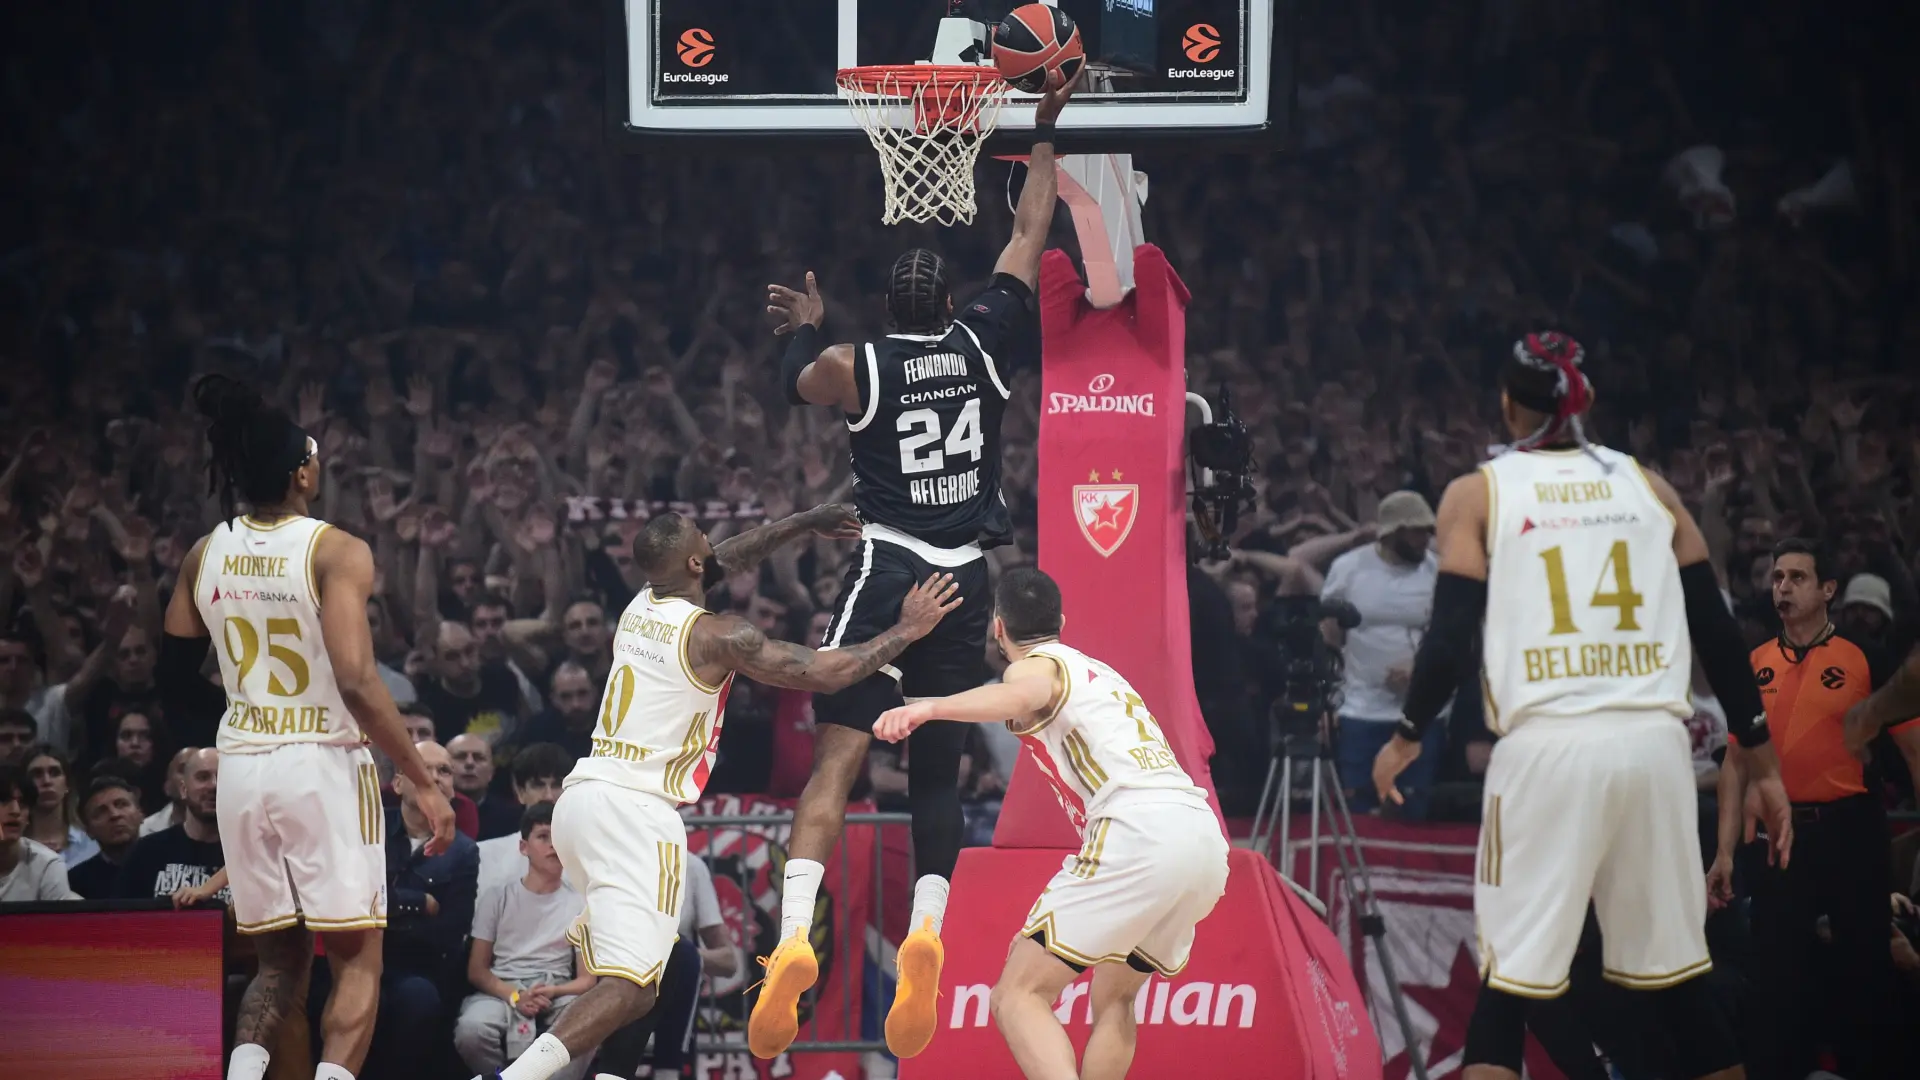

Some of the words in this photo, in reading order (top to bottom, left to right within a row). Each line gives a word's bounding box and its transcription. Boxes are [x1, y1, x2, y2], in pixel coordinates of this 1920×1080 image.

[664, 72, 729, 85] EuroLeague
[1168, 68, 1235, 80] EuroLeague
[904, 353, 967, 385] FERNANDO
[900, 384, 977, 404] CHANGAN
[1048, 392, 1155, 416] SPALDING
[896, 398, 984, 473] 24
[910, 467, 979, 506] BELGRADE
[1081, 492, 1099, 503] KK
[1534, 480, 1613, 504] RIVERO
[222, 555, 288, 577] MONEKE
[1539, 540, 1644, 635] 14
[224, 616, 310, 697] 95
[1523, 641, 1670, 682] BELGRADE
